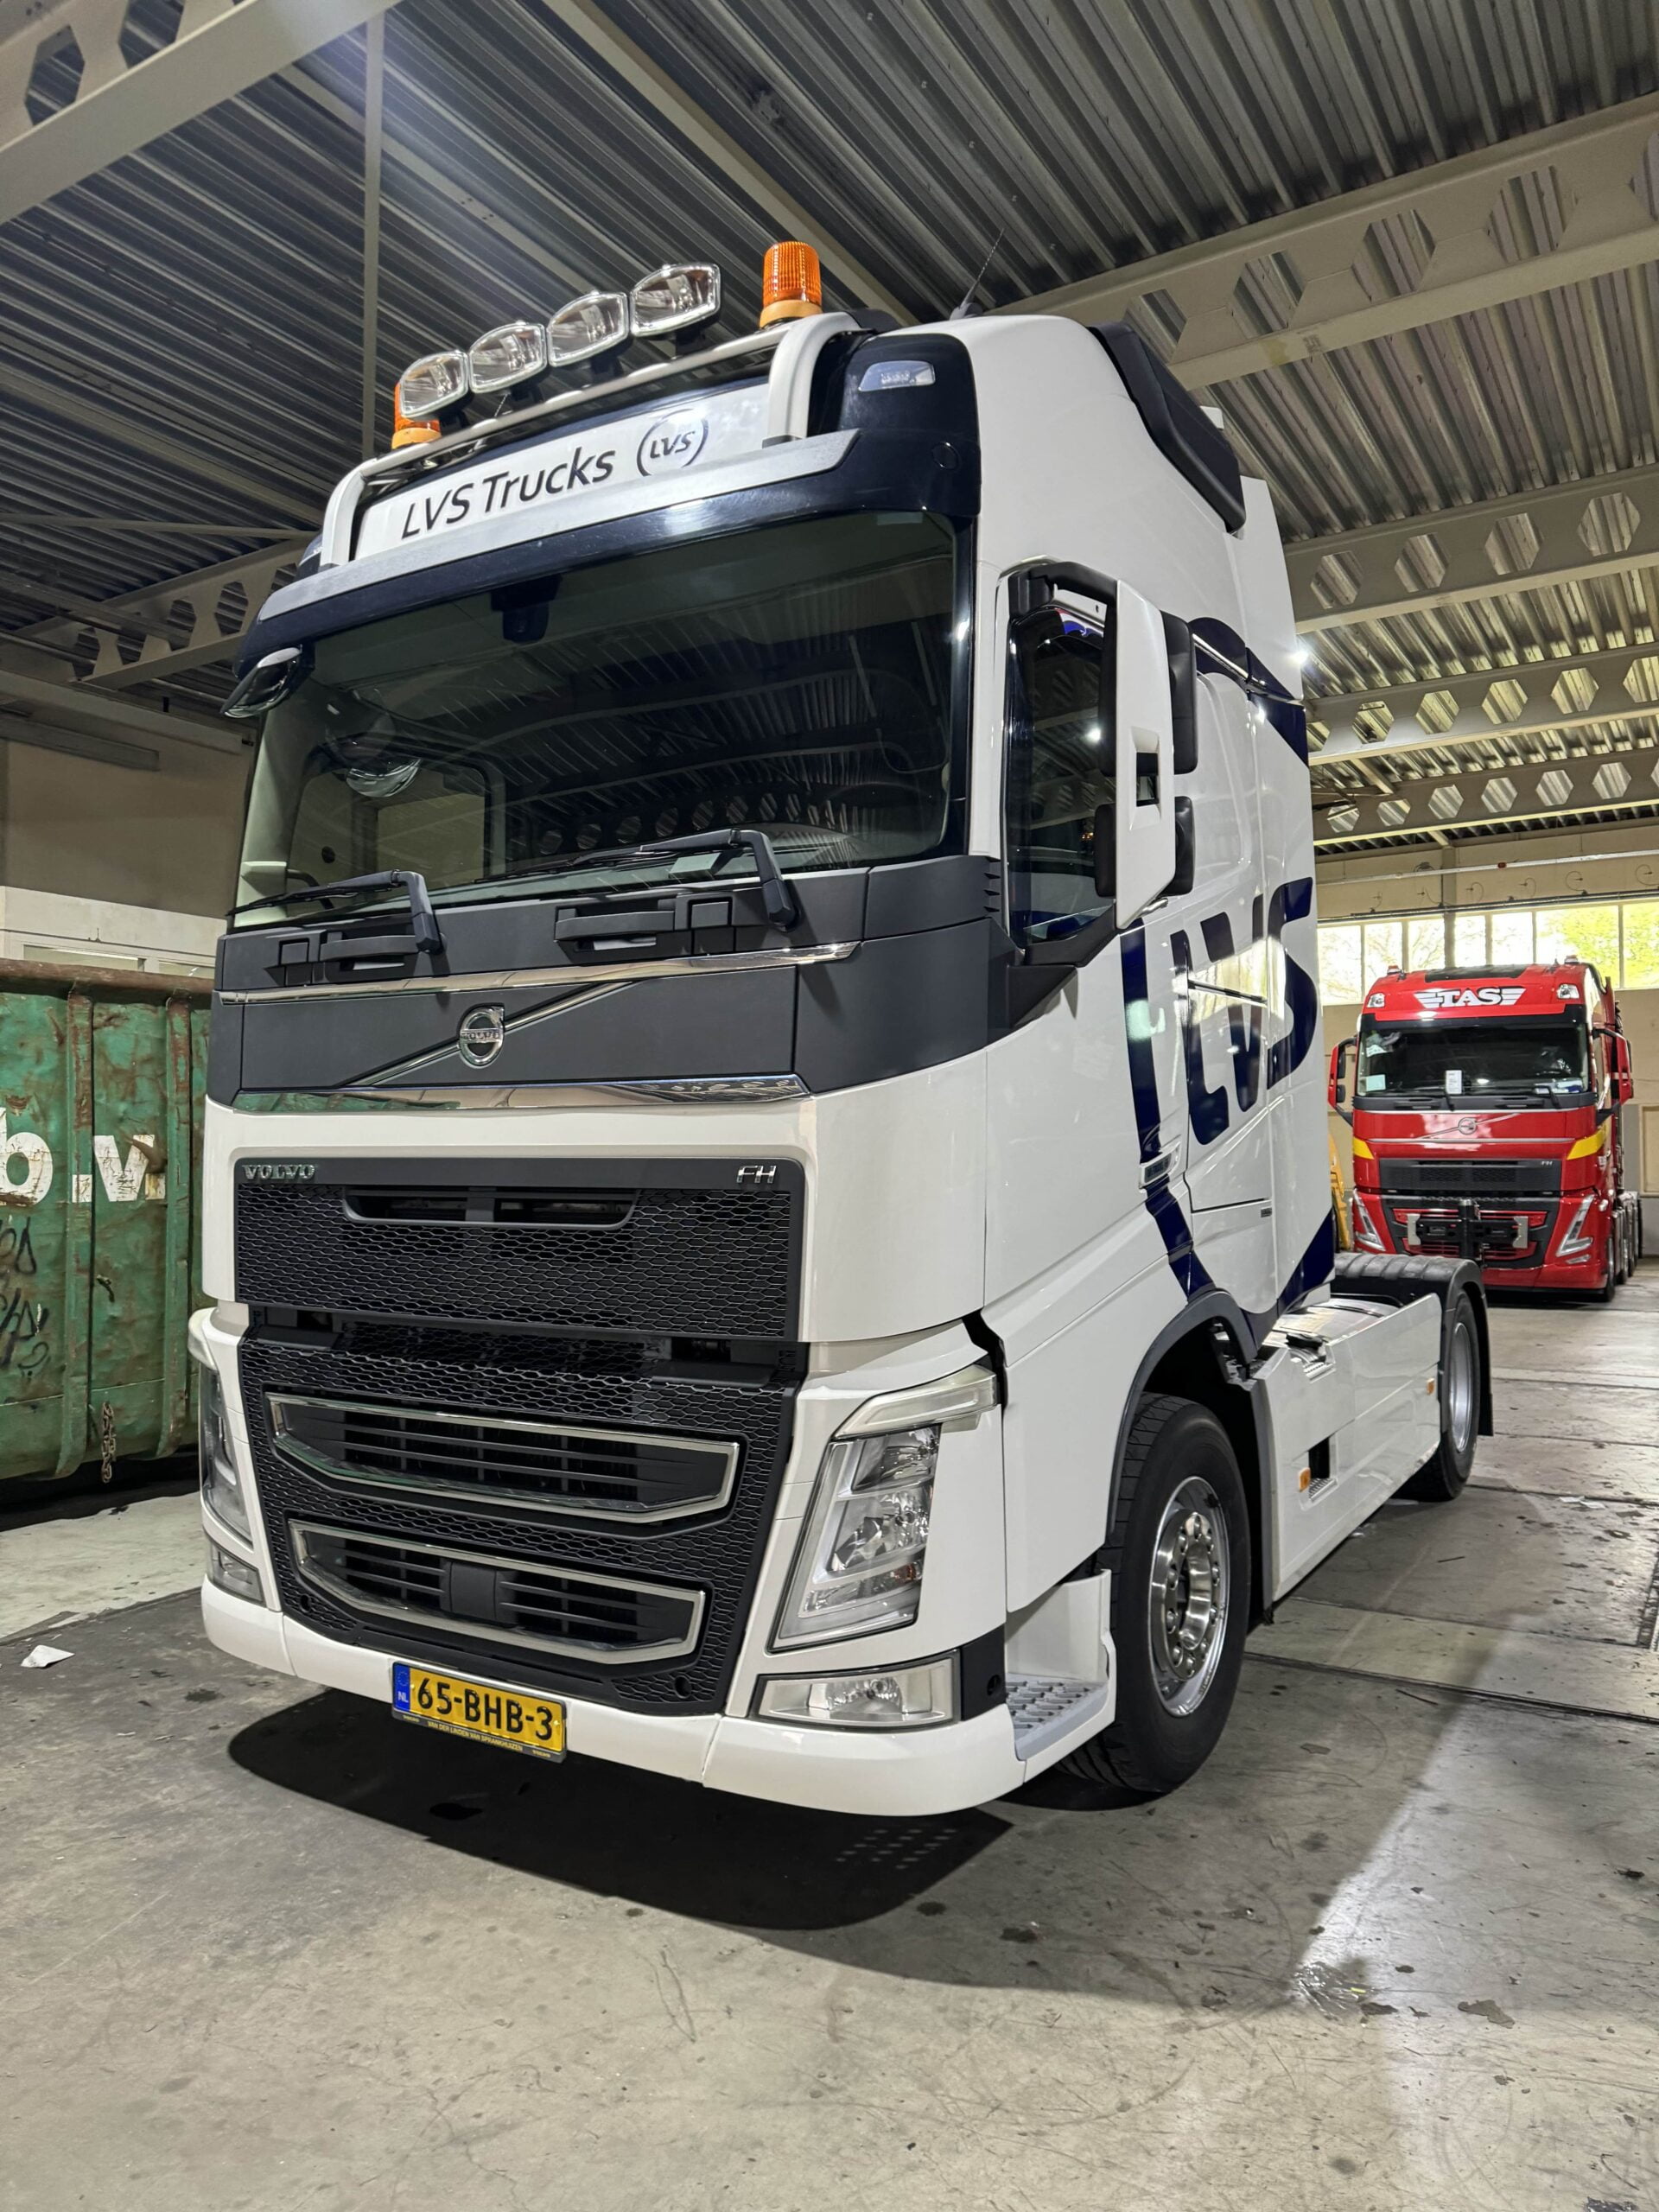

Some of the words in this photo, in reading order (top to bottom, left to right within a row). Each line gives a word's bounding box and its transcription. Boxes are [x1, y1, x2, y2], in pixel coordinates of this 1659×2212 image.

[649, 430, 696, 459] LVS
[401, 482, 474, 540] LVS
[482, 447, 616, 513] Trucks
[1169, 876, 1319, 1146] LVS
[241, 1163, 315, 1179] VOLVO
[736, 1165, 777, 1184] FH
[397, 1690, 409, 1703] NL
[417, 1677, 553, 1741] 65-BHB-3
